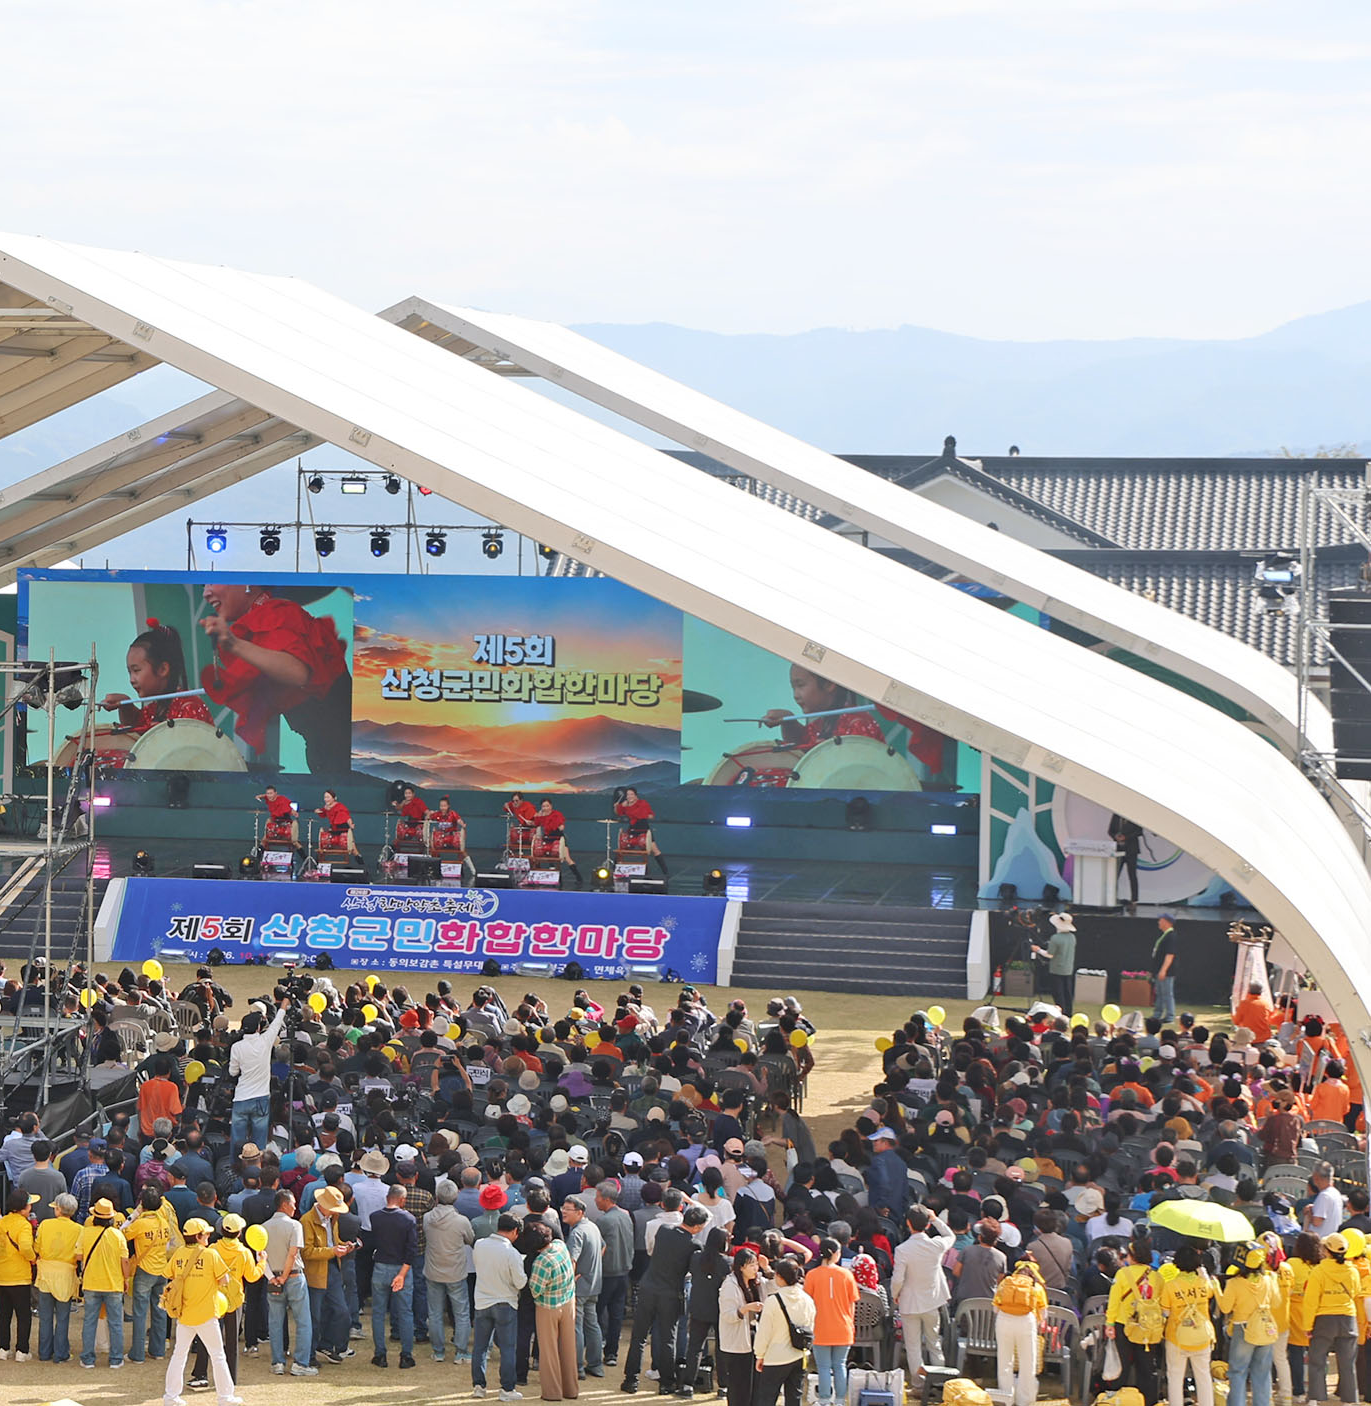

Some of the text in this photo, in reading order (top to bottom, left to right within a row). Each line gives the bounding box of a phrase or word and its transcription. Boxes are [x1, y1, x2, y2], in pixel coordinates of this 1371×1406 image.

[472, 633, 555, 666] 제5회
[380, 668, 663, 707] 산청군민화합한마당
[341, 896, 474, 915] 산청한방약초축제
[167, 913, 671, 961] 제5회 산청군민화합한마당
[388, 959, 438, 968] 동의보감촌
[443, 959, 484, 971] 특설무대
